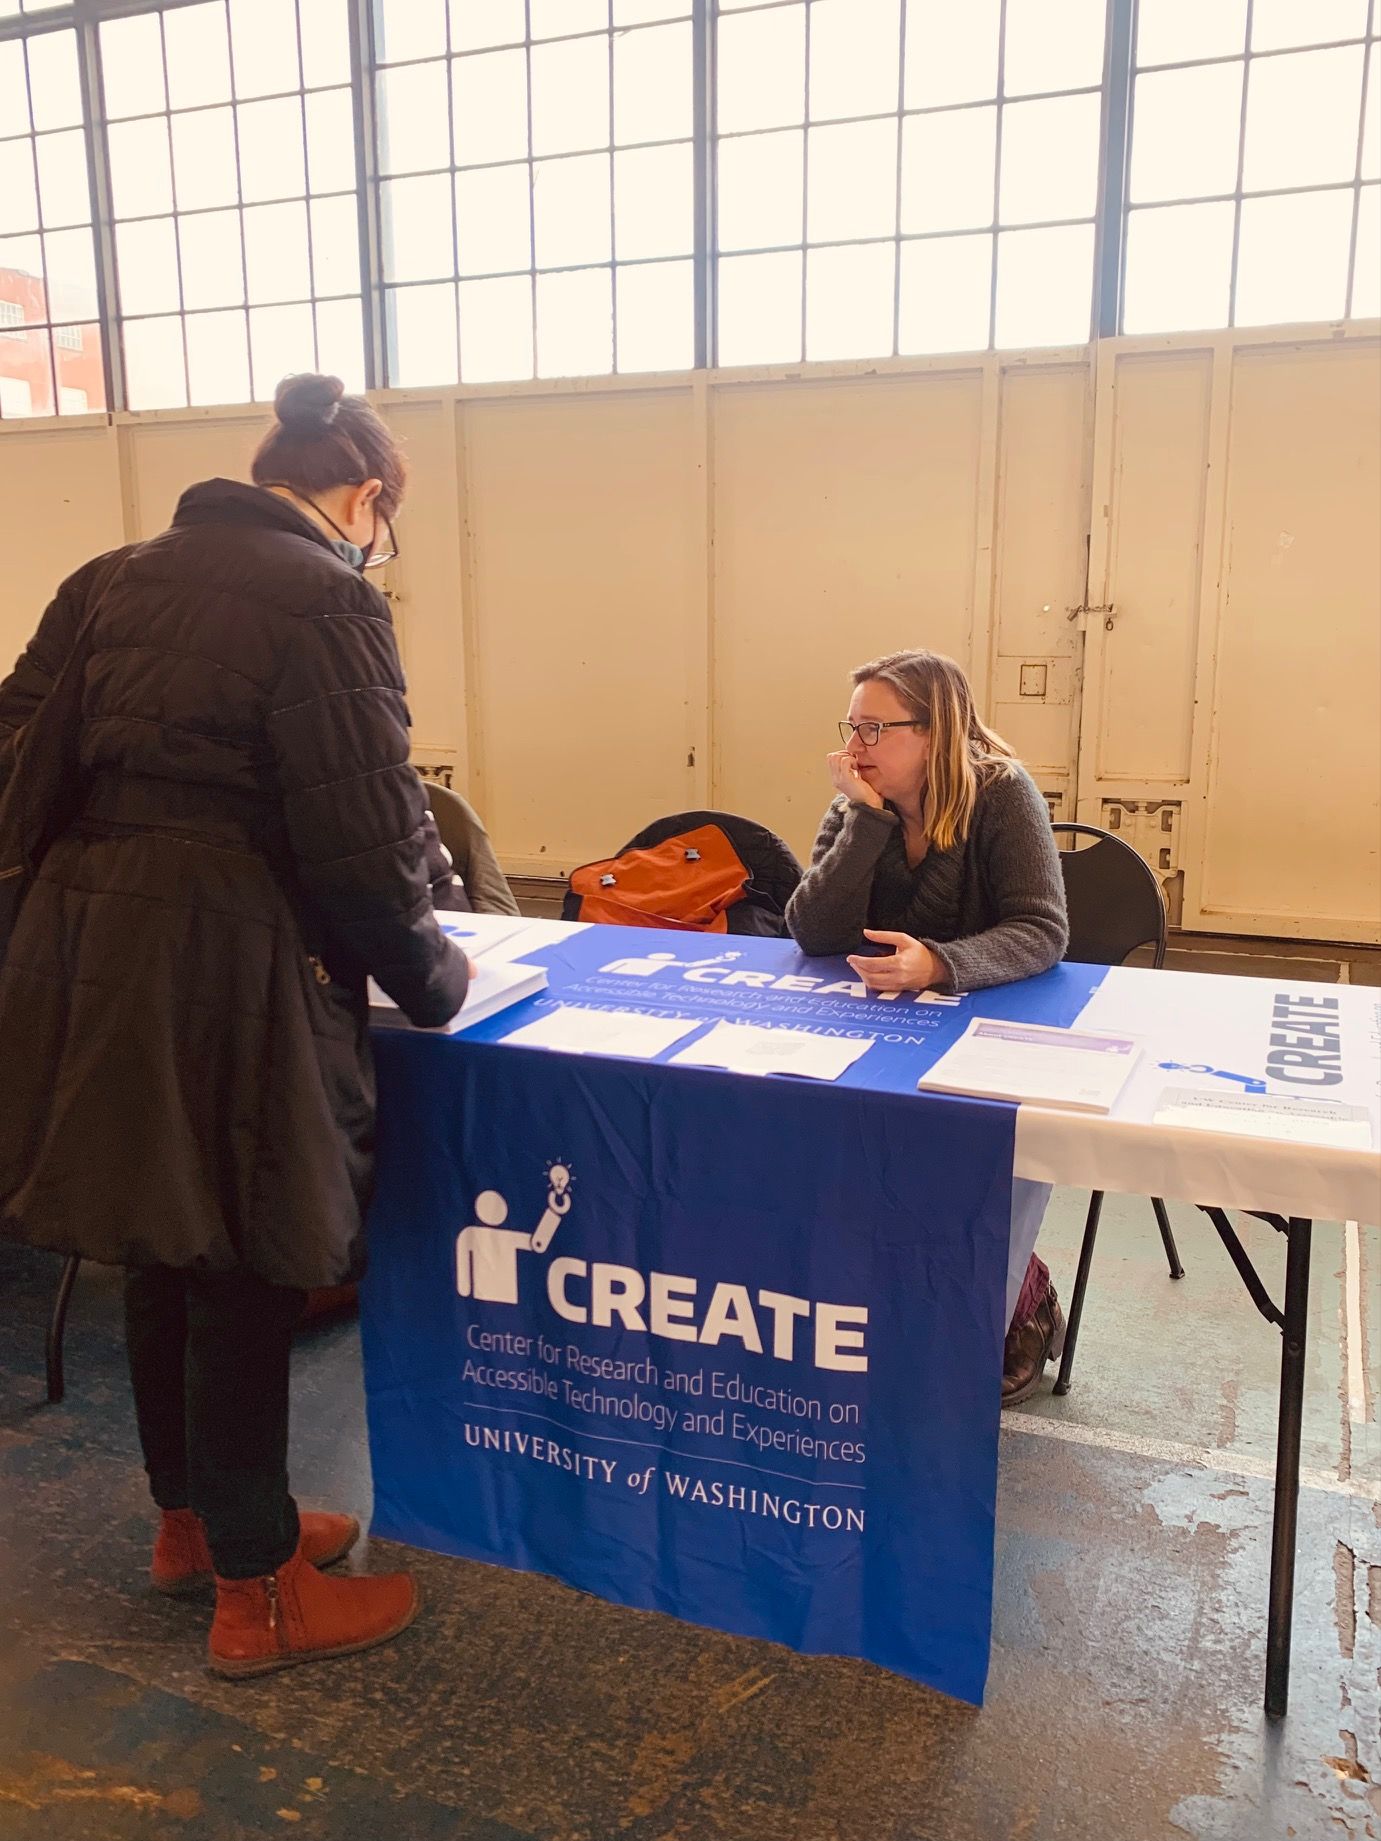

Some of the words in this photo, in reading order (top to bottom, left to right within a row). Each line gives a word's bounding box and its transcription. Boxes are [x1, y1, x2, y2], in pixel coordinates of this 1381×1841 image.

[563, 983, 657, 999] Accessible
[662, 991, 770, 1012] Technology
[772, 1001, 813, 1014] and
[815, 1007, 942, 1028] Experiences
[585, 976, 648, 989] Center
[648, 982, 677, 991] for
[678, 983, 768, 1000] Research
[768, 992, 803, 1004] and
[807, 996, 910, 1015] Education
[915, 1008, 942, 1018] on
[1265, 993, 1344, 1086] CREATE
[546, 1256, 868, 1373] CREATE
[462, 1359, 558, 1400] Accessible
[562, 1379, 678, 1432] Technology
[683, 1409, 724, 1436] and
[732, 1413, 866, 1464] Experiences
[467, 1324, 534, 1356] Center
[537, 1334, 562, 1365] for
[566, 1345, 658, 1386] Research
[664, 1368, 703, 1396] and
[712, 1371, 821, 1421] Education
[829, 1403, 859, 1424] on
[464, 1423, 617, 1483] UNIVERSITY
[627, 1467, 656, 1495] of
[664, 1471, 865, 1533] WASHINGTON
